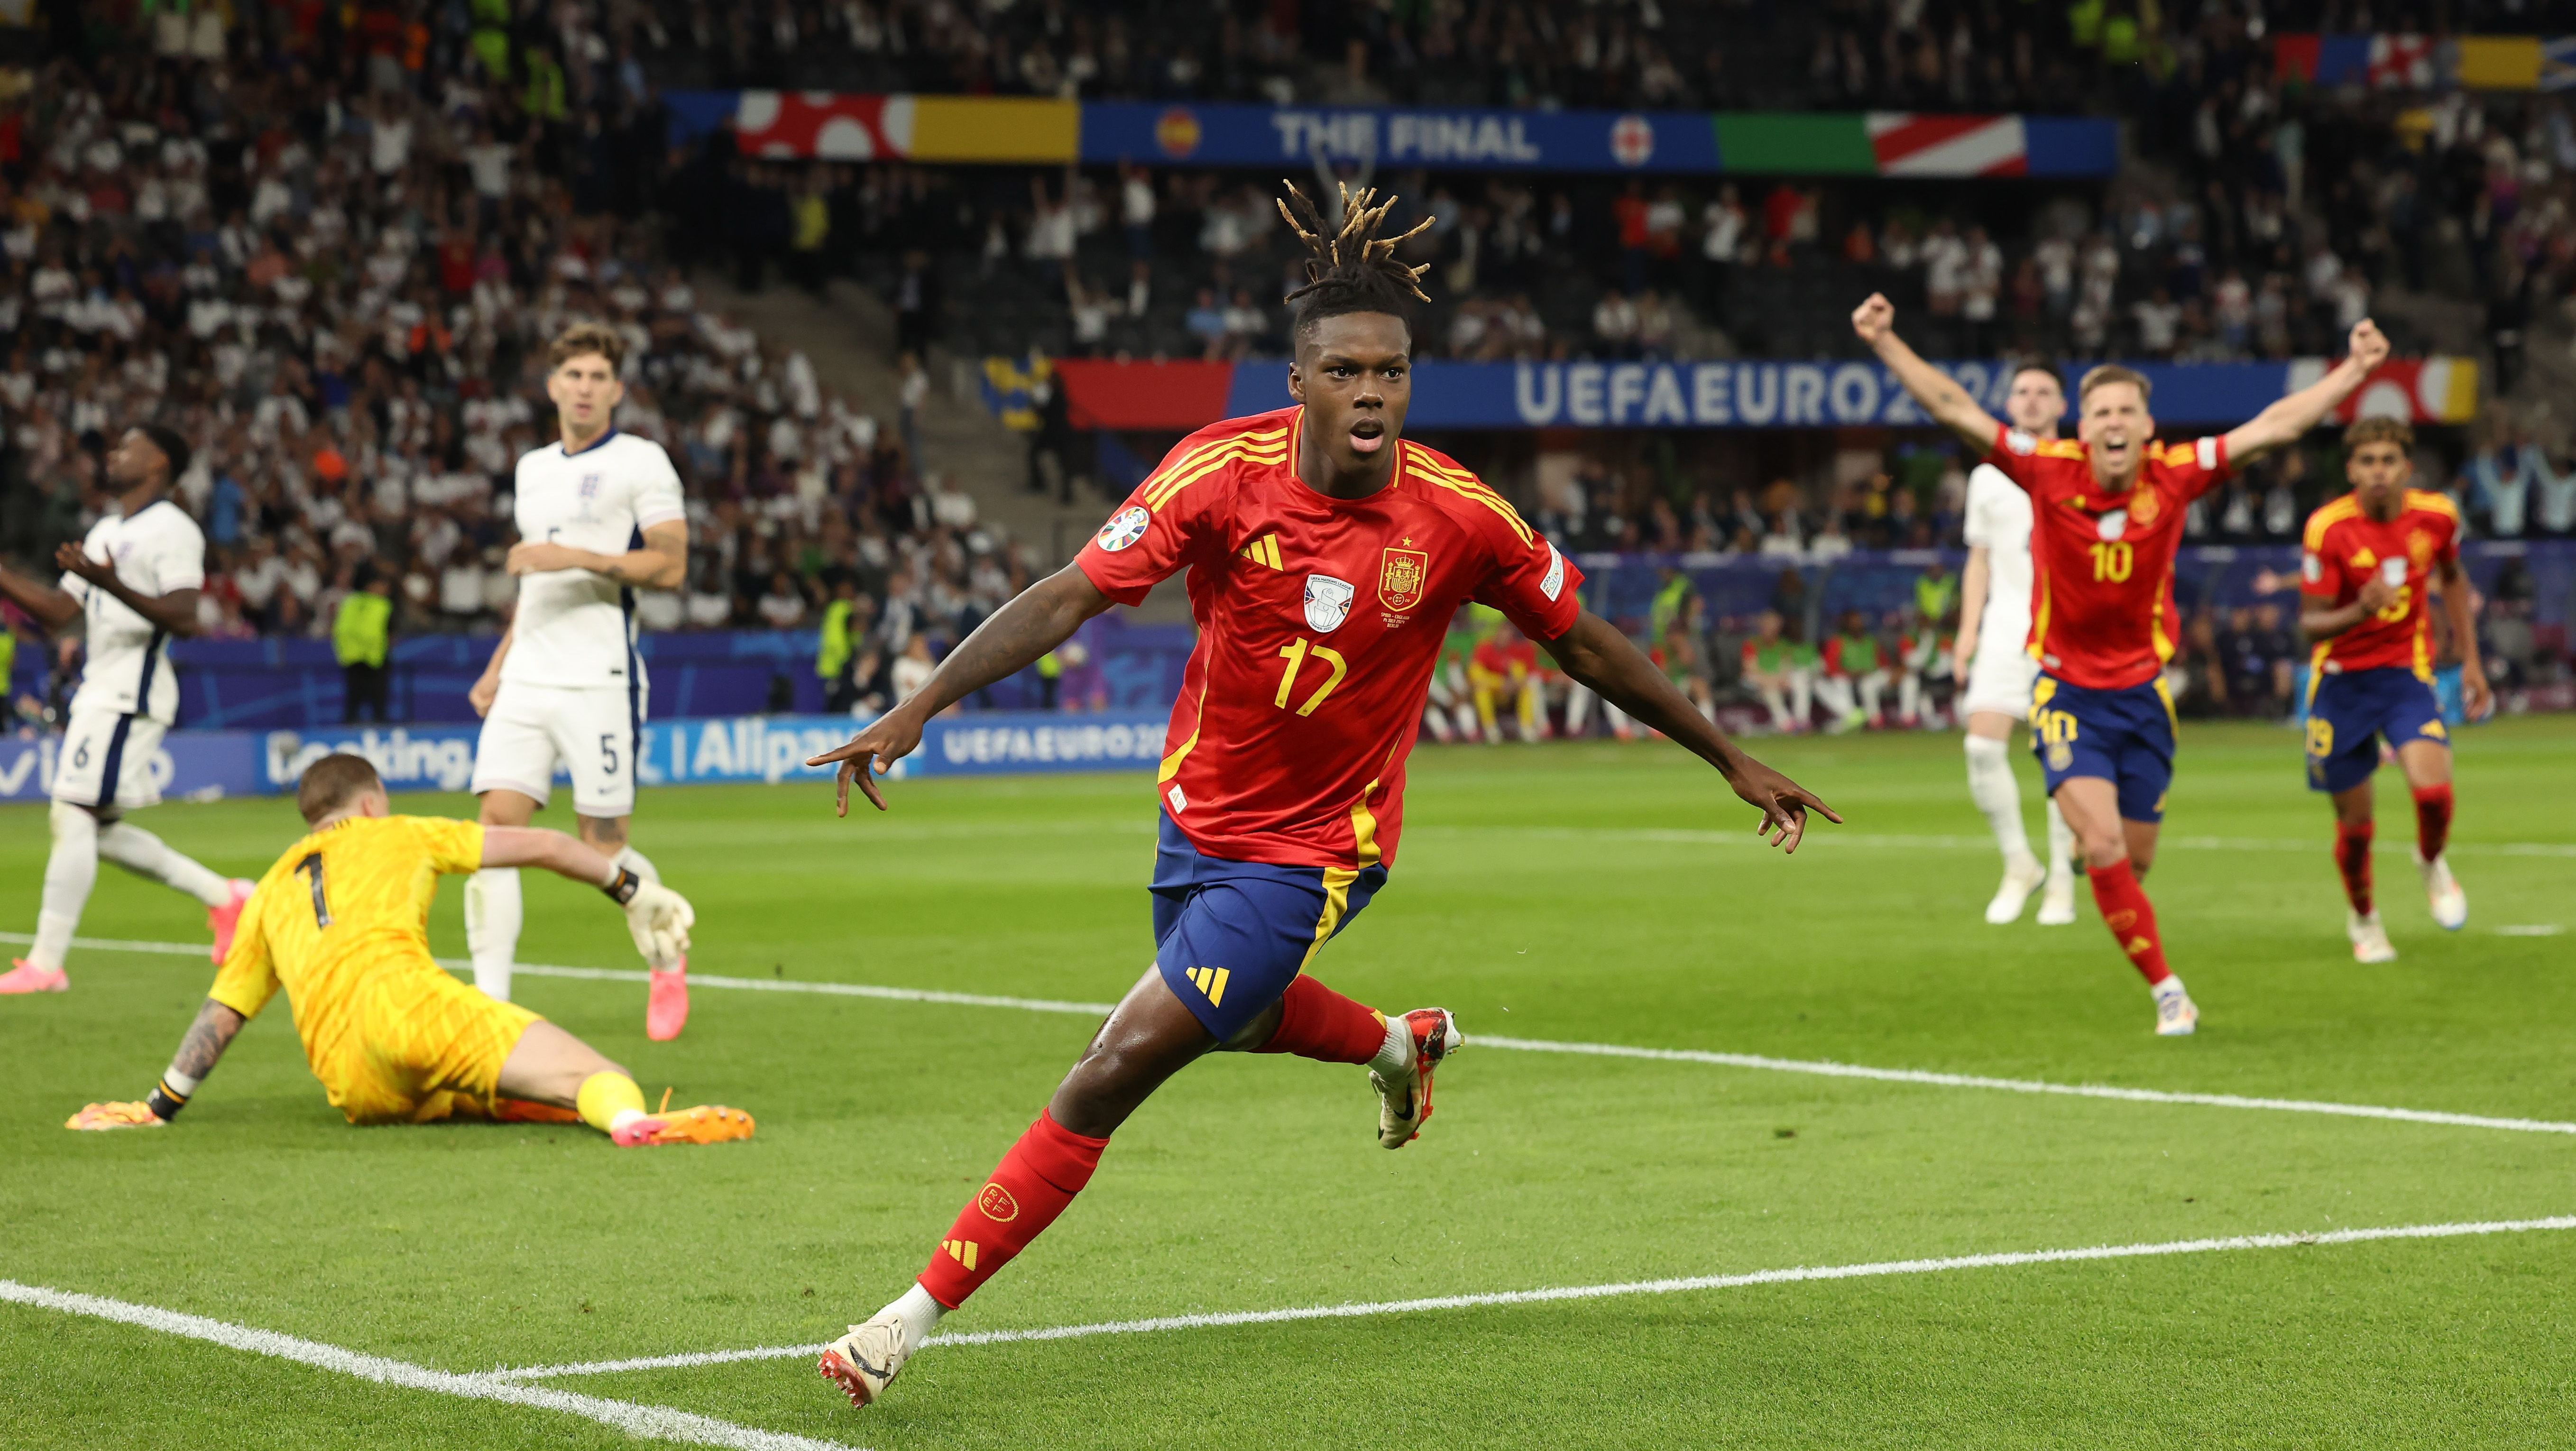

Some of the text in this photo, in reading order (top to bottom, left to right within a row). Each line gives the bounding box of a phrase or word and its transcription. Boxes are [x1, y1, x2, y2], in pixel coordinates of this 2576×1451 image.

[1272, 111, 1540, 160] THE FINAL
[2089, 541, 2133, 583] 10
[1275, 637, 1347, 717] 17
[74, 735, 90, 769] 6
[600, 733, 617, 775] 5
[294, 852, 329, 931] 1
